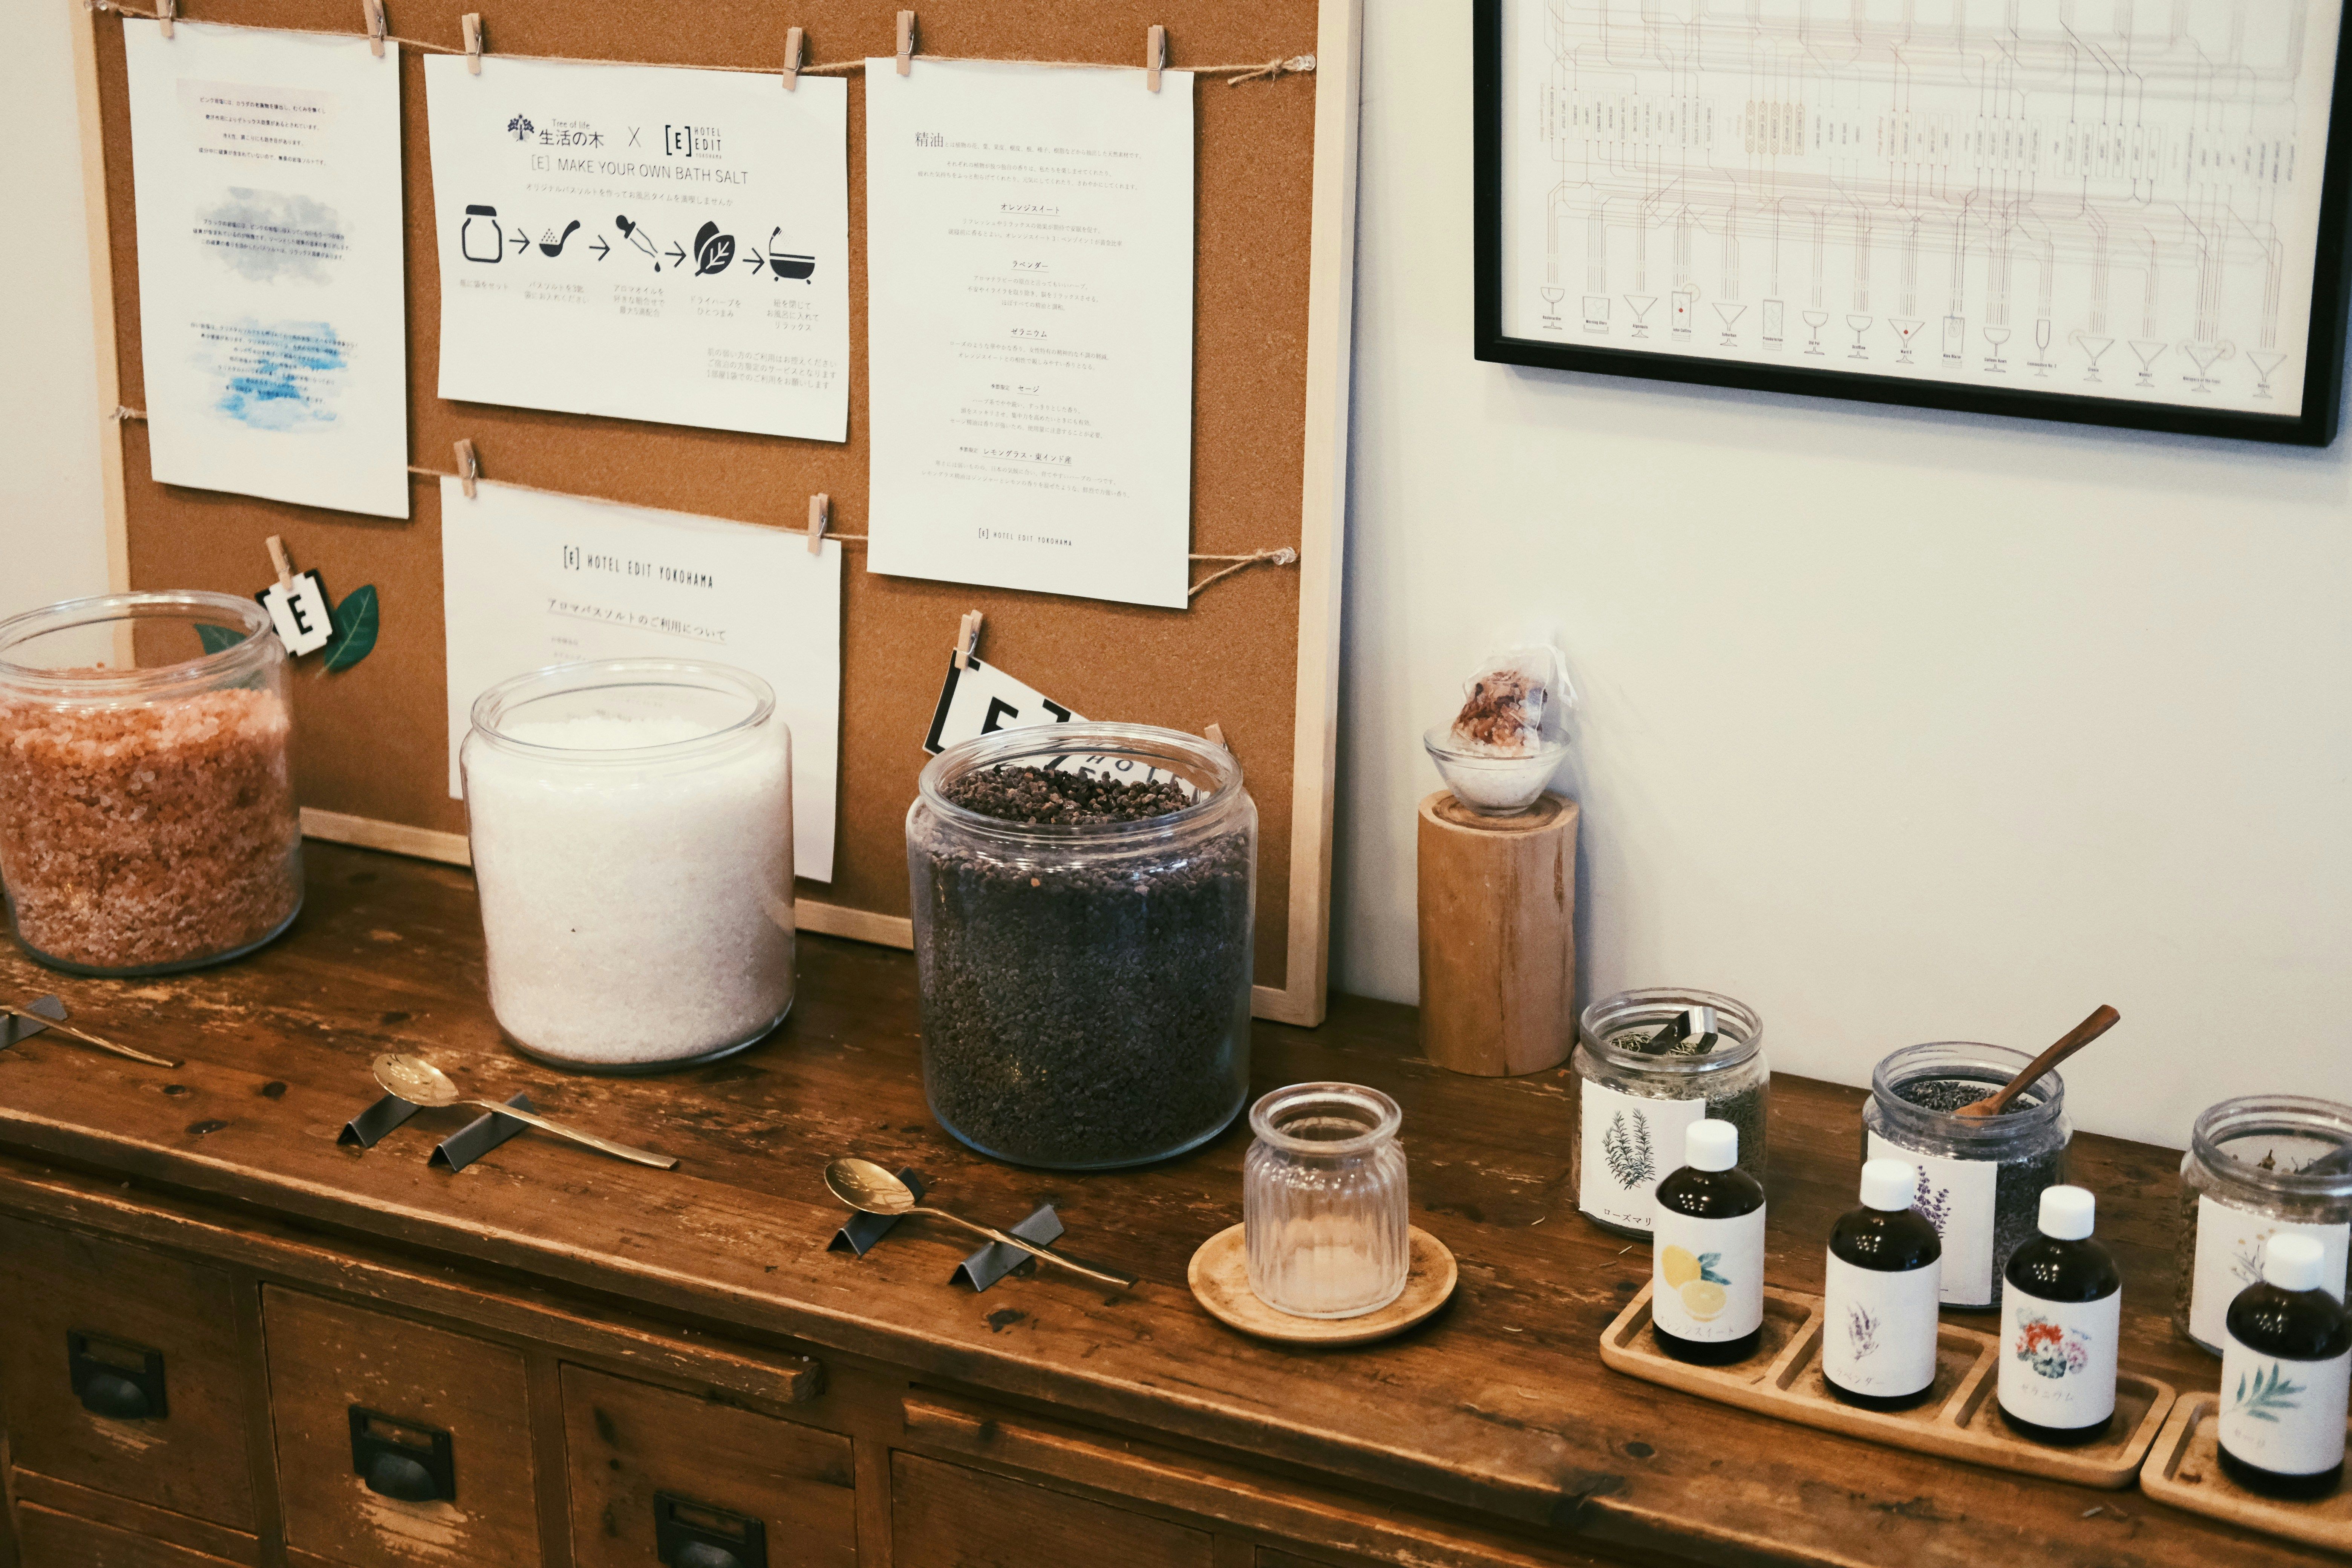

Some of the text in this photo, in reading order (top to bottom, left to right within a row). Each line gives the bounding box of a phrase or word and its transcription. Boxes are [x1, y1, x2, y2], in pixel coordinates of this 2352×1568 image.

[551, 118, 567, 128] Tree
[694, 127, 721, 137] HOTEL
[539, 129, 604, 149] 生活の木
[695, 138, 721, 151] EDIT
[531, 154, 749, 185] [E] MAKE YOUR OWN BATH SALT
[1000, 203, 1060, 214] オレンジスイート
[1011, 260, 1048, 271] ラベンダー
[776, 322, 811, 331] リラックス
[1010, 328, 1047, 338] ゼラニウム
[1017, 385, 1040, 394] セージ
[983, 449, 1072, 464] レモングラス・東インド産
[993, 531, 1013, 540] HOTEL
[1038, 536, 1072, 547] YOKOHAMA
[564, 544, 713, 590] [E] HOTEL EDIT YOKOHAMA
[548, 597, 726, 642] アロマバスソルトのご利用について
[1605, 1209, 1651, 1226] ローズマリ
